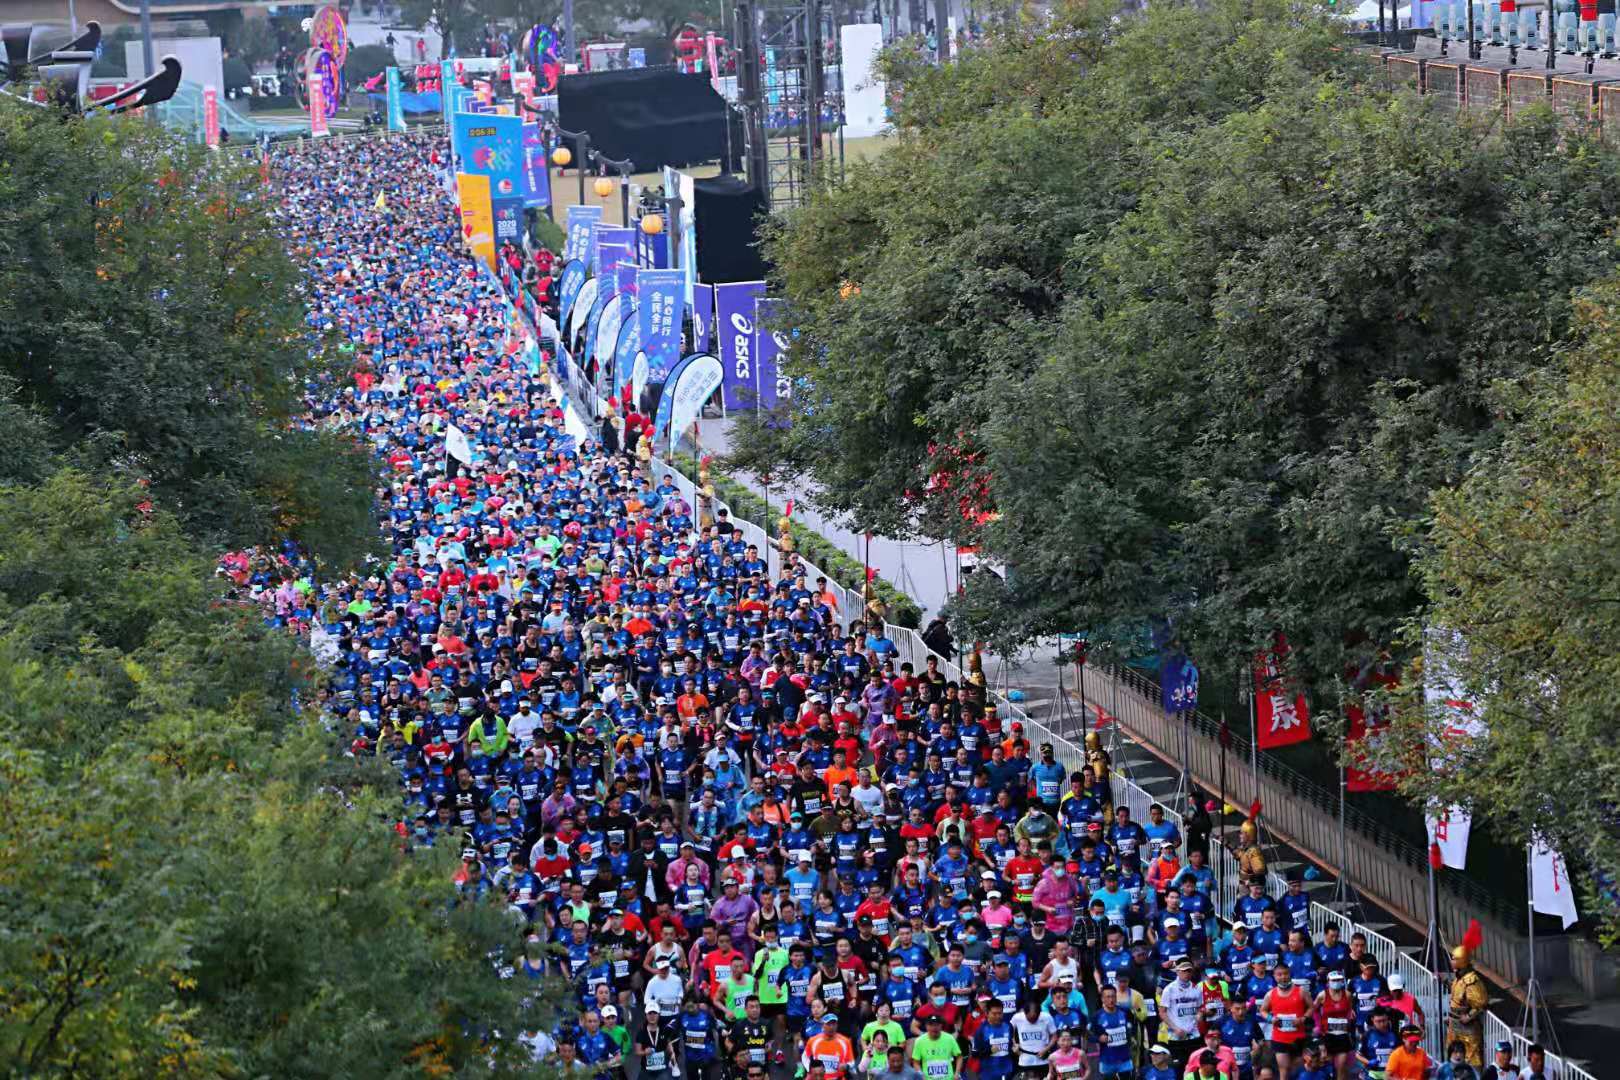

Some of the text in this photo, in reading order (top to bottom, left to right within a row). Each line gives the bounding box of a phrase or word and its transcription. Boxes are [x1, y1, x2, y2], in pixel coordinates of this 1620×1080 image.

[497, 220, 517, 228] 2020
[735, 334, 750, 379] asics
[747, 1037, 765, 1045] Jeep
